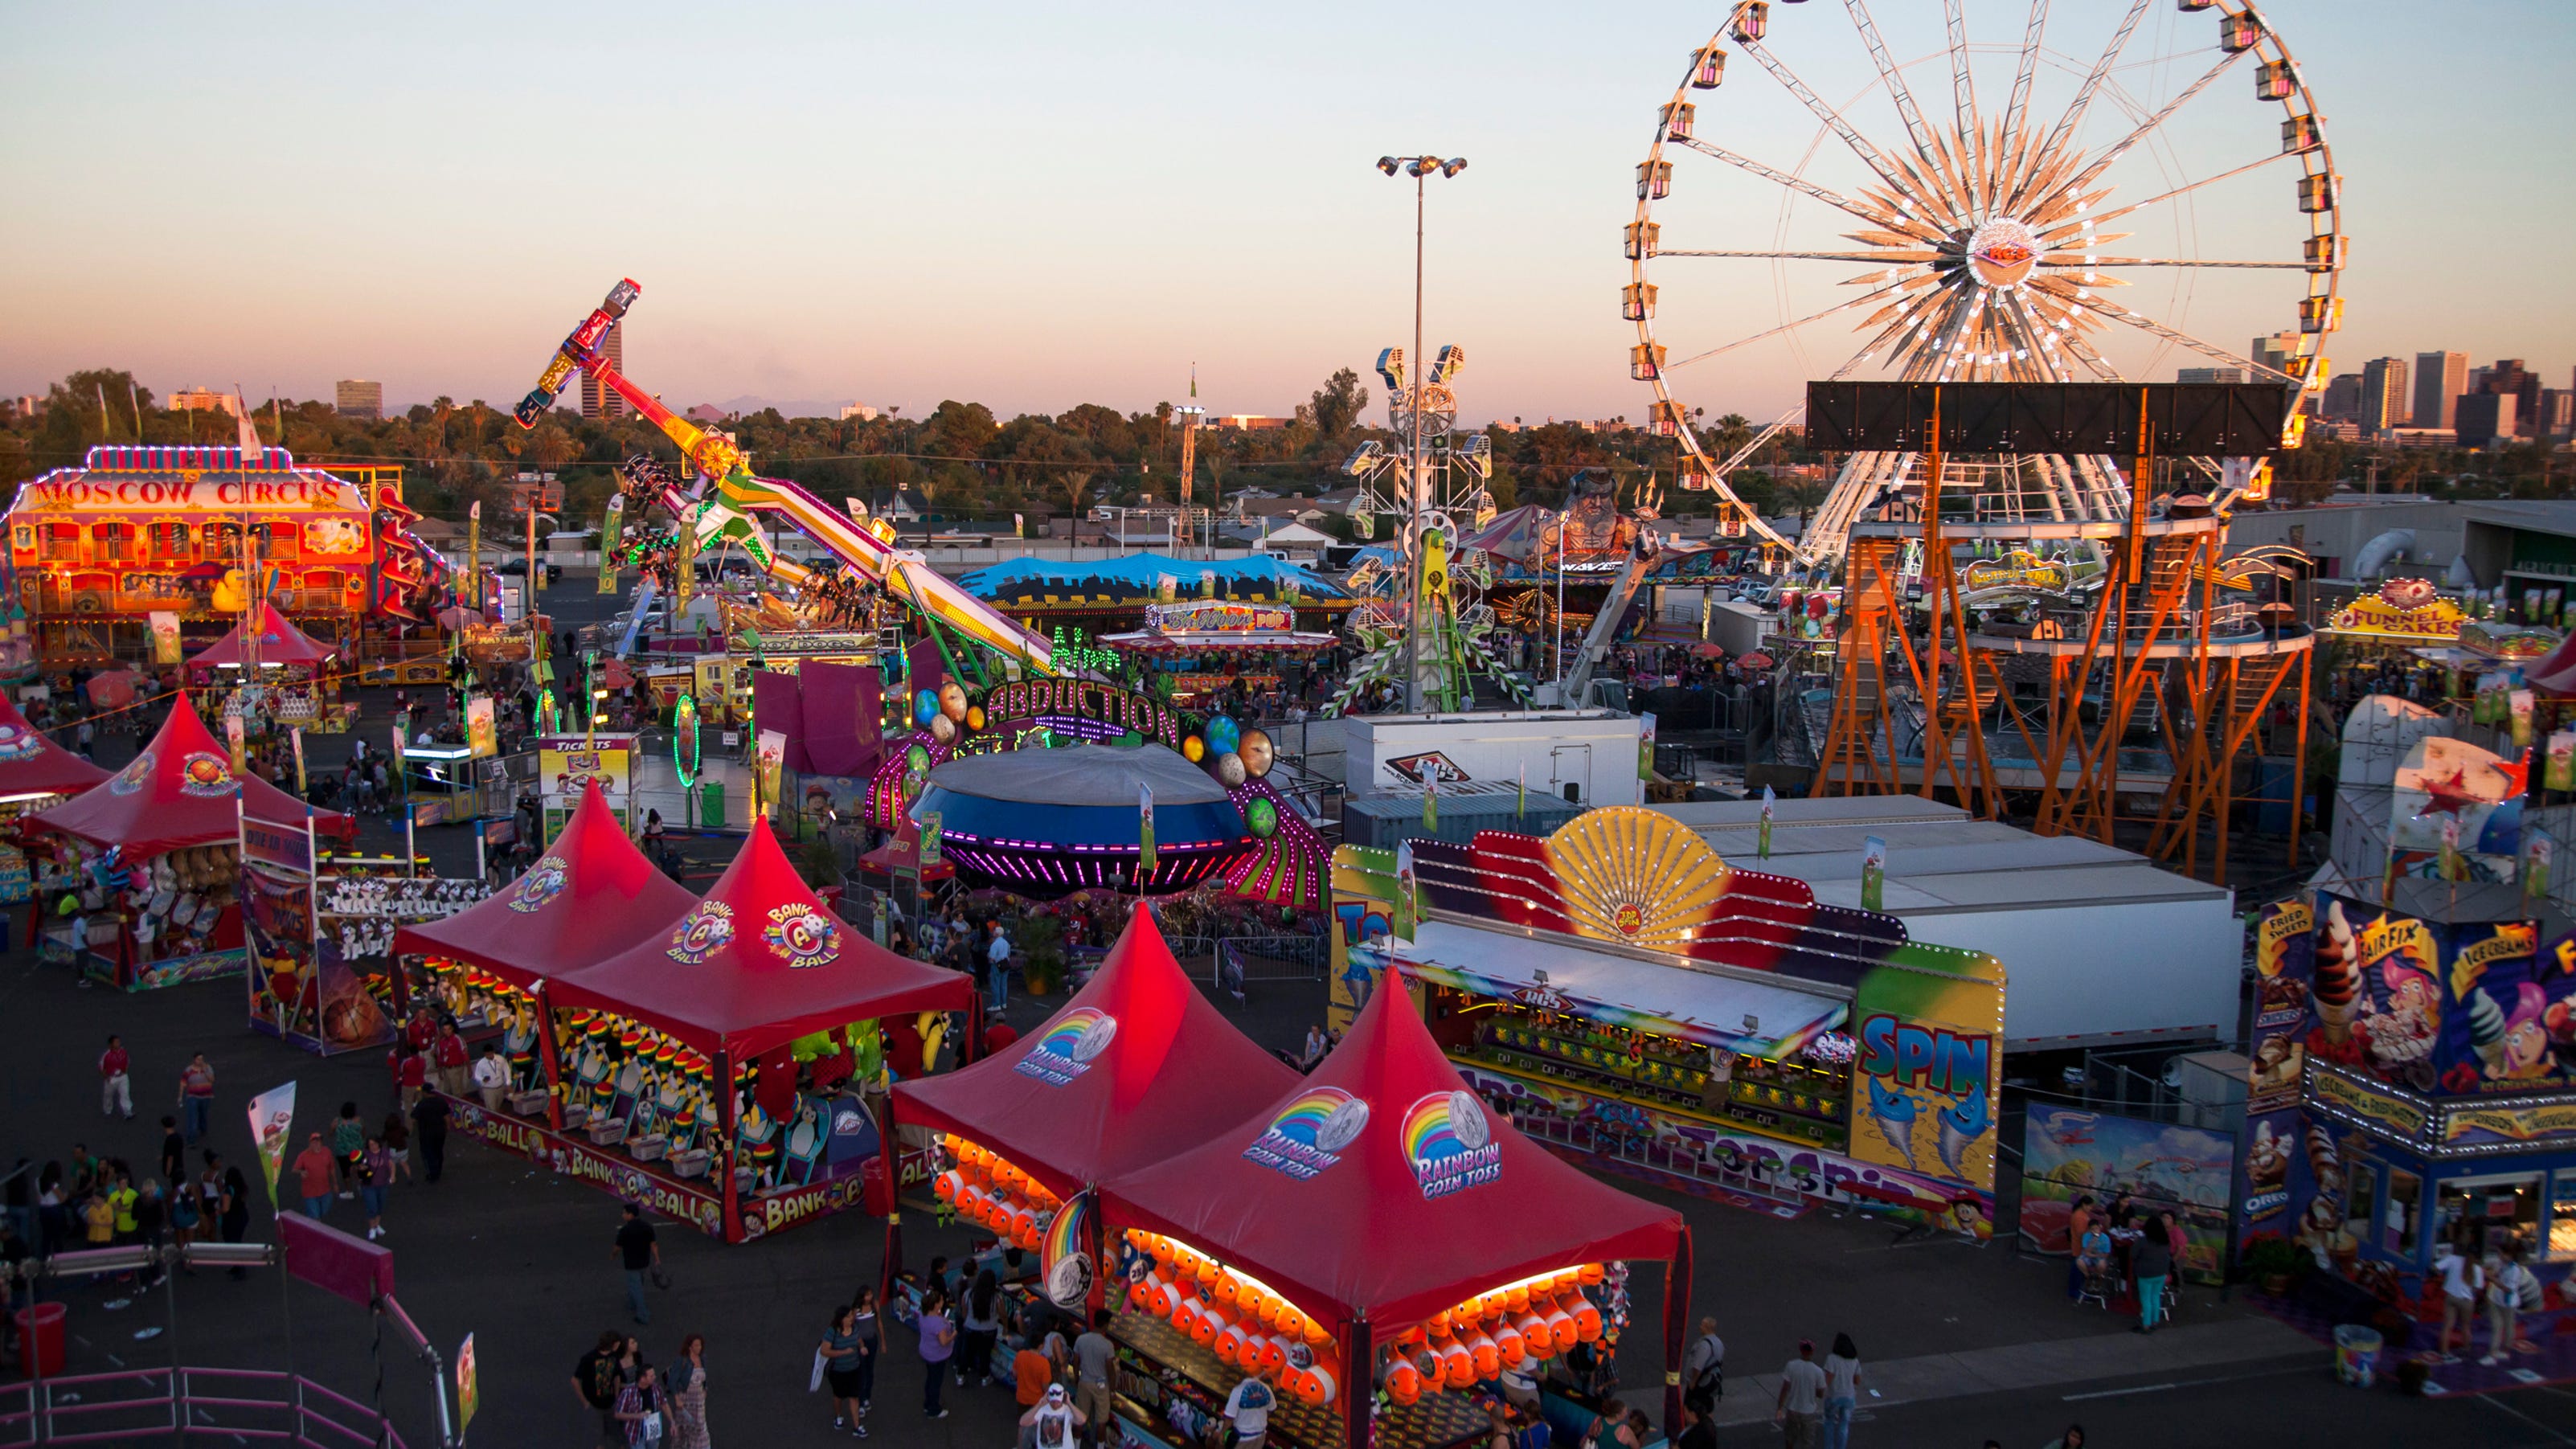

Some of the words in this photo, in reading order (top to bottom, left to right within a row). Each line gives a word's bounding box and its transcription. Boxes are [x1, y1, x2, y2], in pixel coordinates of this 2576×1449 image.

[1989, 247, 2029, 260] RCS
[34, 481, 194, 505] MOSCOW
[217, 481, 342, 505] CIRCUS
[1168, 610, 1253, 630] Balloon
[1256, 613, 1286, 628] POP
[2353, 608, 2443, 627] FUNNEL
[2383, 620, 2462, 636] CAKES
[797, 639, 857, 649] DOGS
[1050, 625, 1121, 673] Alien
[987, 677, 1182, 754] ABDUCTION
[555, 739, 612, 752] TICKTS
[542, 856, 569, 871] BANK
[531, 878, 547, 893] A
[508, 899, 540, 913] BALL
[702, 900, 735, 919] BANK
[767, 903, 813, 925] BANK
[1620, 910, 1638, 919] TOP
[1333, 900, 1423, 948] TO
[1618, 917, 1640, 928] SPIN
[2269, 909, 2304, 930] FRIED
[2269, 918, 2309, 939] SWEETS
[690, 923, 710, 942] A
[792, 927, 811, 948] A
[666, 947, 703, 965] BALL
[789, 951, 840, 969] BALL
[2463, 947, 2487, 966] ICE
[2488, 935, 2535, 958] CREAMS
[1526, 989, 1562, 1010] RCS
[1024, 1046, 1091, 1075] RAINBOW
[1857, 1013, 1994, 1097] SPIN
[1013, 1061, 1044, 1080] COIN
[1042, 1068, 1075, 1087] TOSS
[486, 1120, 530, 1155] BALL
[1252, 1128, 1341, 1171] RAINBOW
[1242, 1146, 1282, 1169] COIN
[1279, 1157, 1322, 1181] TOSS
[1418, 1143, 1501, 1185] RAINBOW
[571, 1147, 616, 1185] BANK
[626, 1173, 640, 1196] A
[654, 1189, 703, 1226] BALL
[1423, 1173, 1462, 1200] COIN
[1464, 1163, 1502, 1190] TOSS
[765, 1189, 828, 1232] BANK
[848, 1177, 862, 1198] A
[2245, 1192, 2290, 1211] OREO
